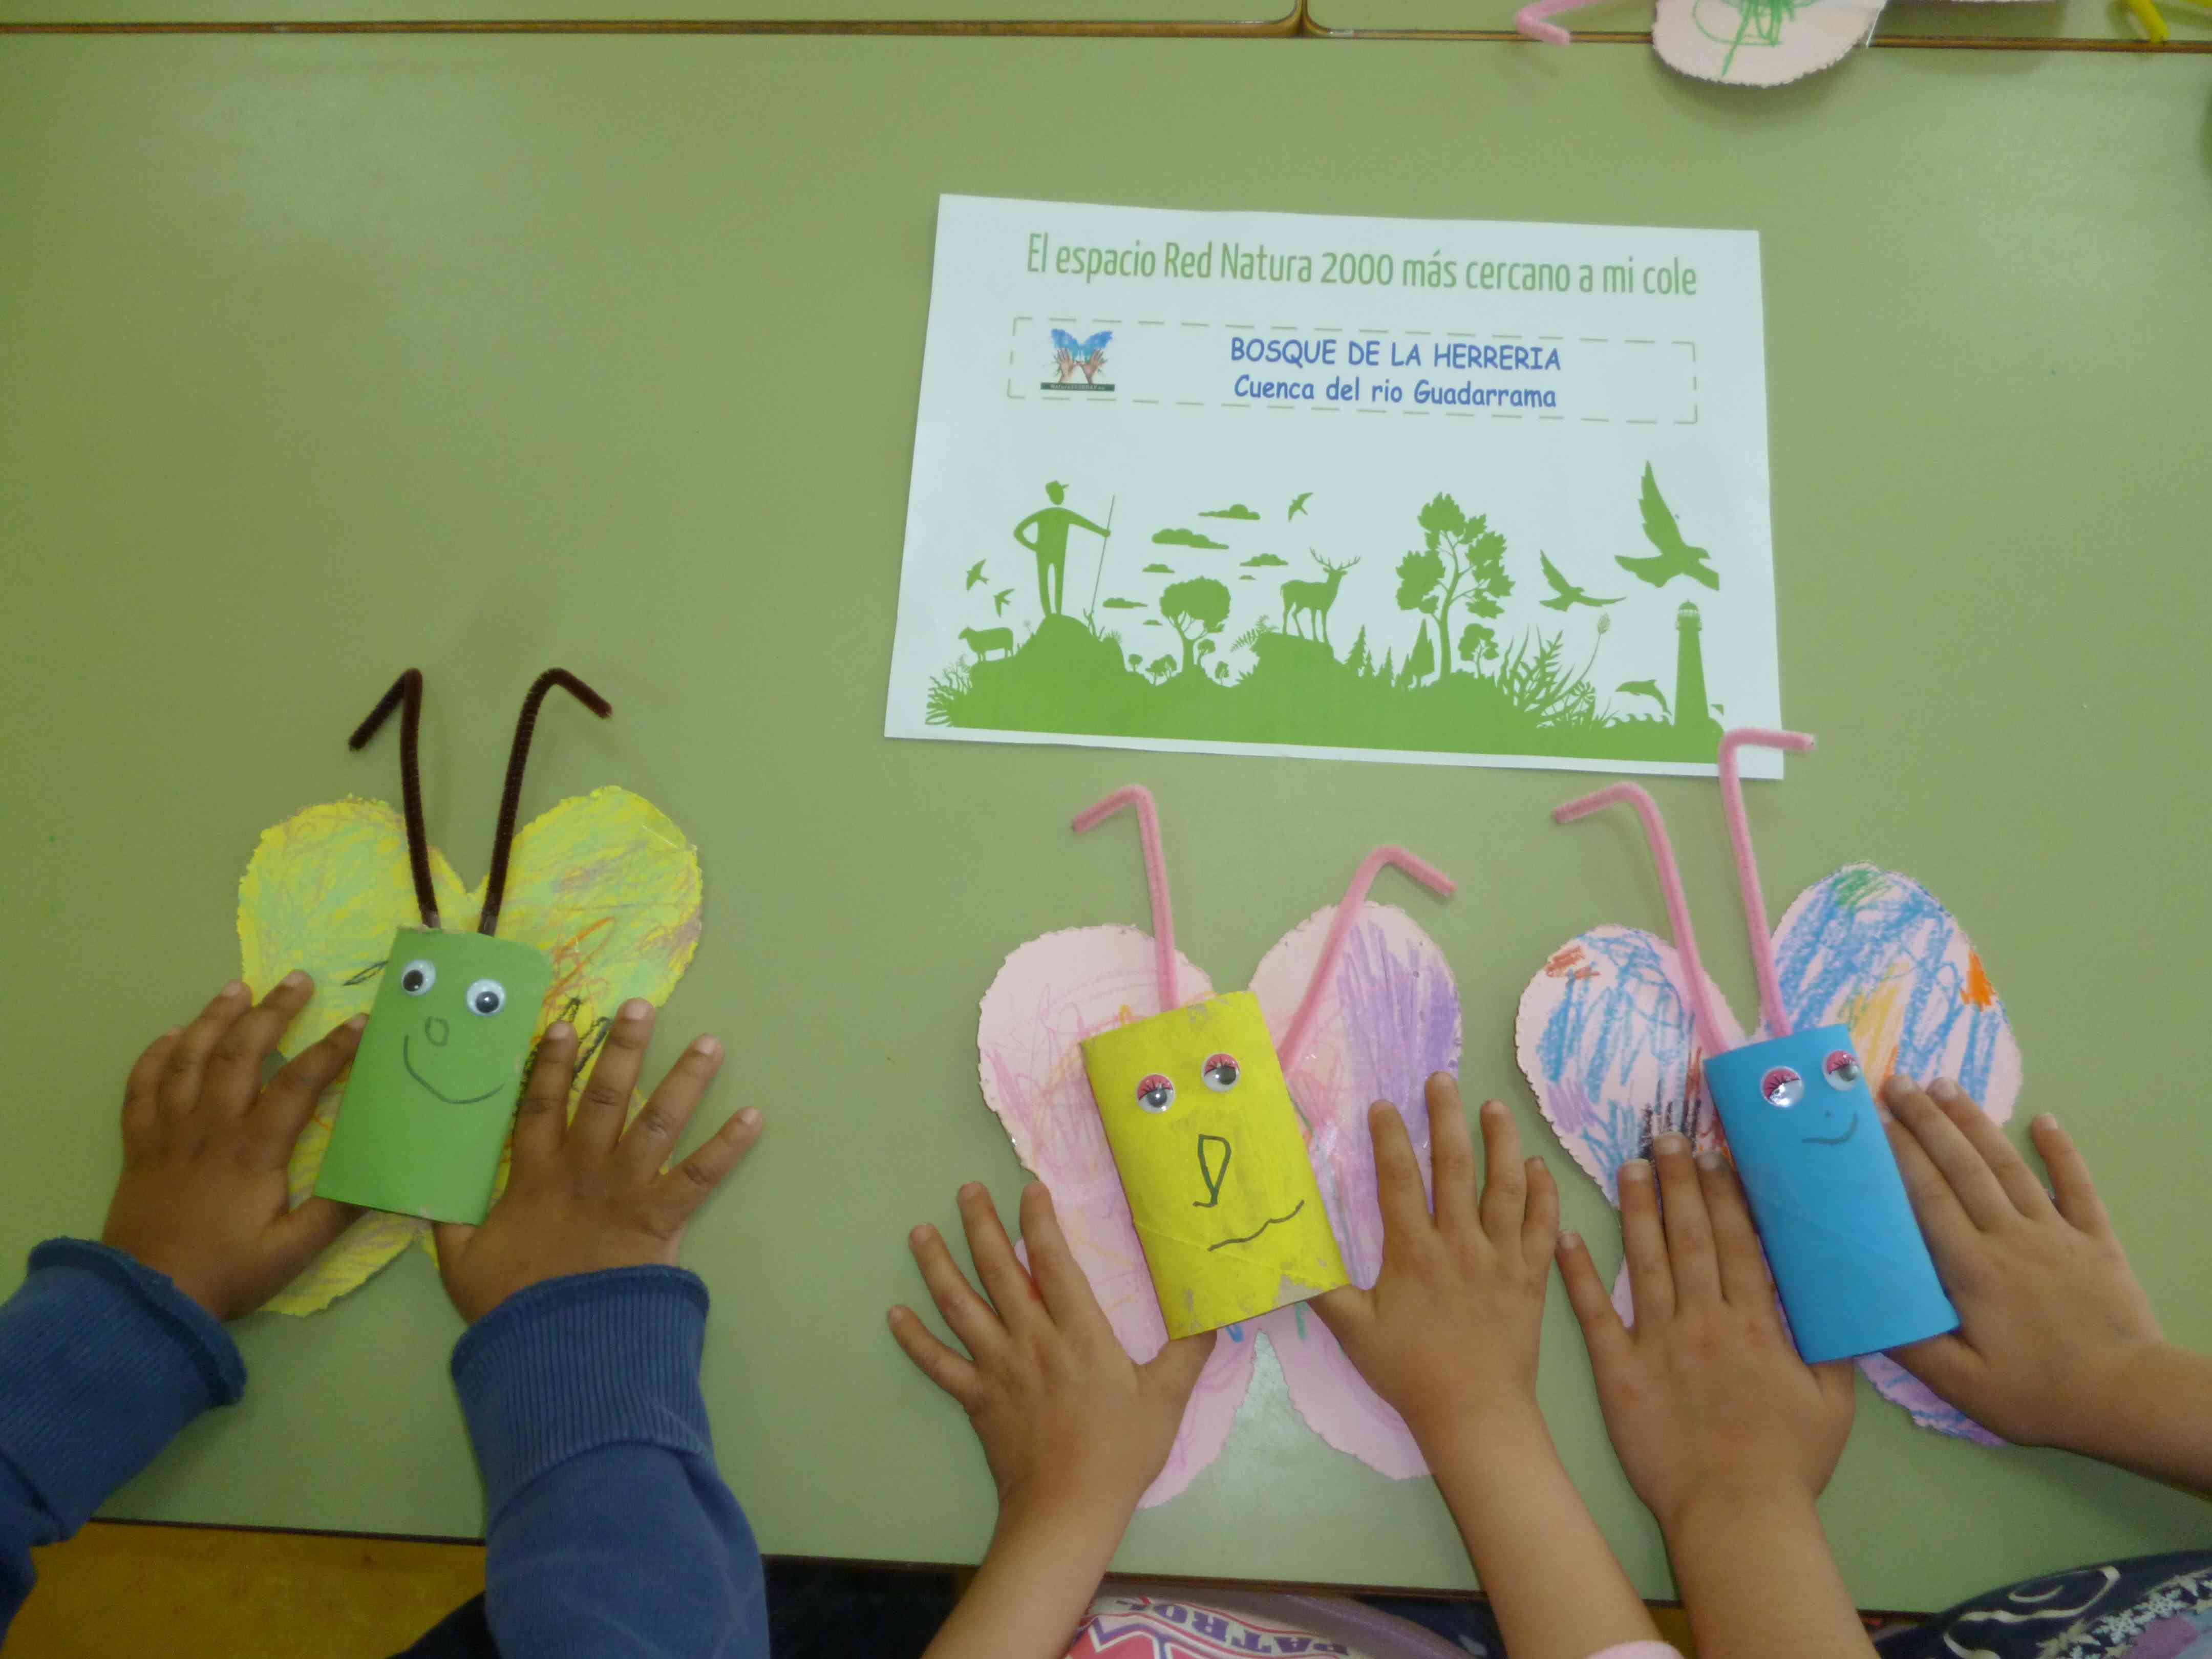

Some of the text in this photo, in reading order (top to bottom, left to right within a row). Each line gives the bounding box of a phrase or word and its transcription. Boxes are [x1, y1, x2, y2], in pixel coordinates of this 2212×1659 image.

[1027, 232, 1696, 295] El espacio Red Natura 2000 más cercano a mi cole
[1231, 336, 1561, 371] BOSQUE DE LA HERRERIA
[1234, 374, 1557, 408] Cuenca del rio Guadarrama
